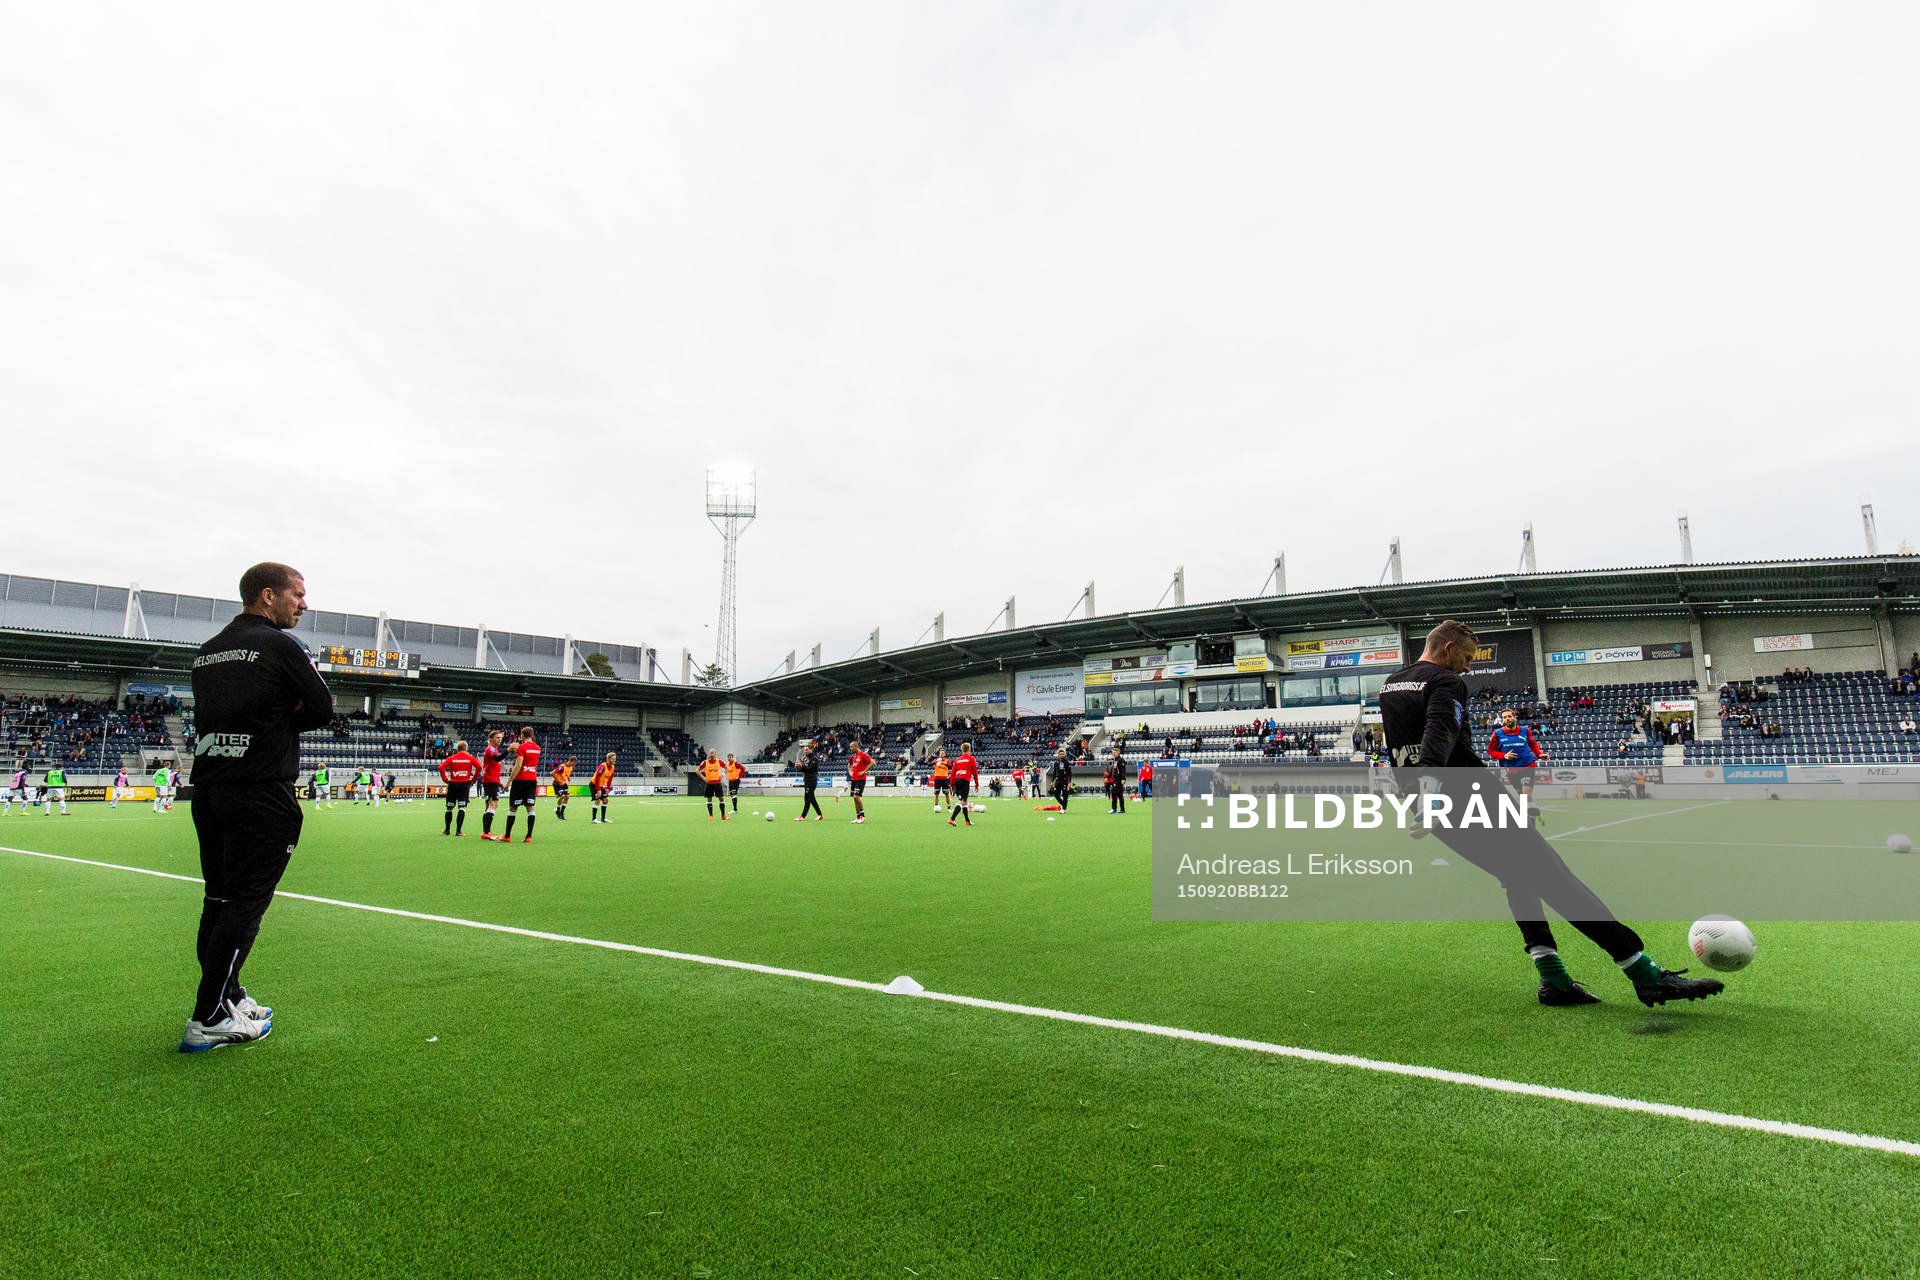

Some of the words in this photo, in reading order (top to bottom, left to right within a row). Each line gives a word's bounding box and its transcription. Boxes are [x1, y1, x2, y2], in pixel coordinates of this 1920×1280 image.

[1324, 639, 1359, 647] SHARP
[247, 650, 259, 662] IF
[1552, 652, 1586, 662] TPM
[1330, 658, 1353, 667] KPMG
[1036, 684, 1055, 694] Gävle
[1055, 683, 1077, 694] Energi
[444, 702, 469, 710] PRECIS
[1736, 770, 1784, 778] REJLERS
[1867, 768, 1899, 776] MEJ
